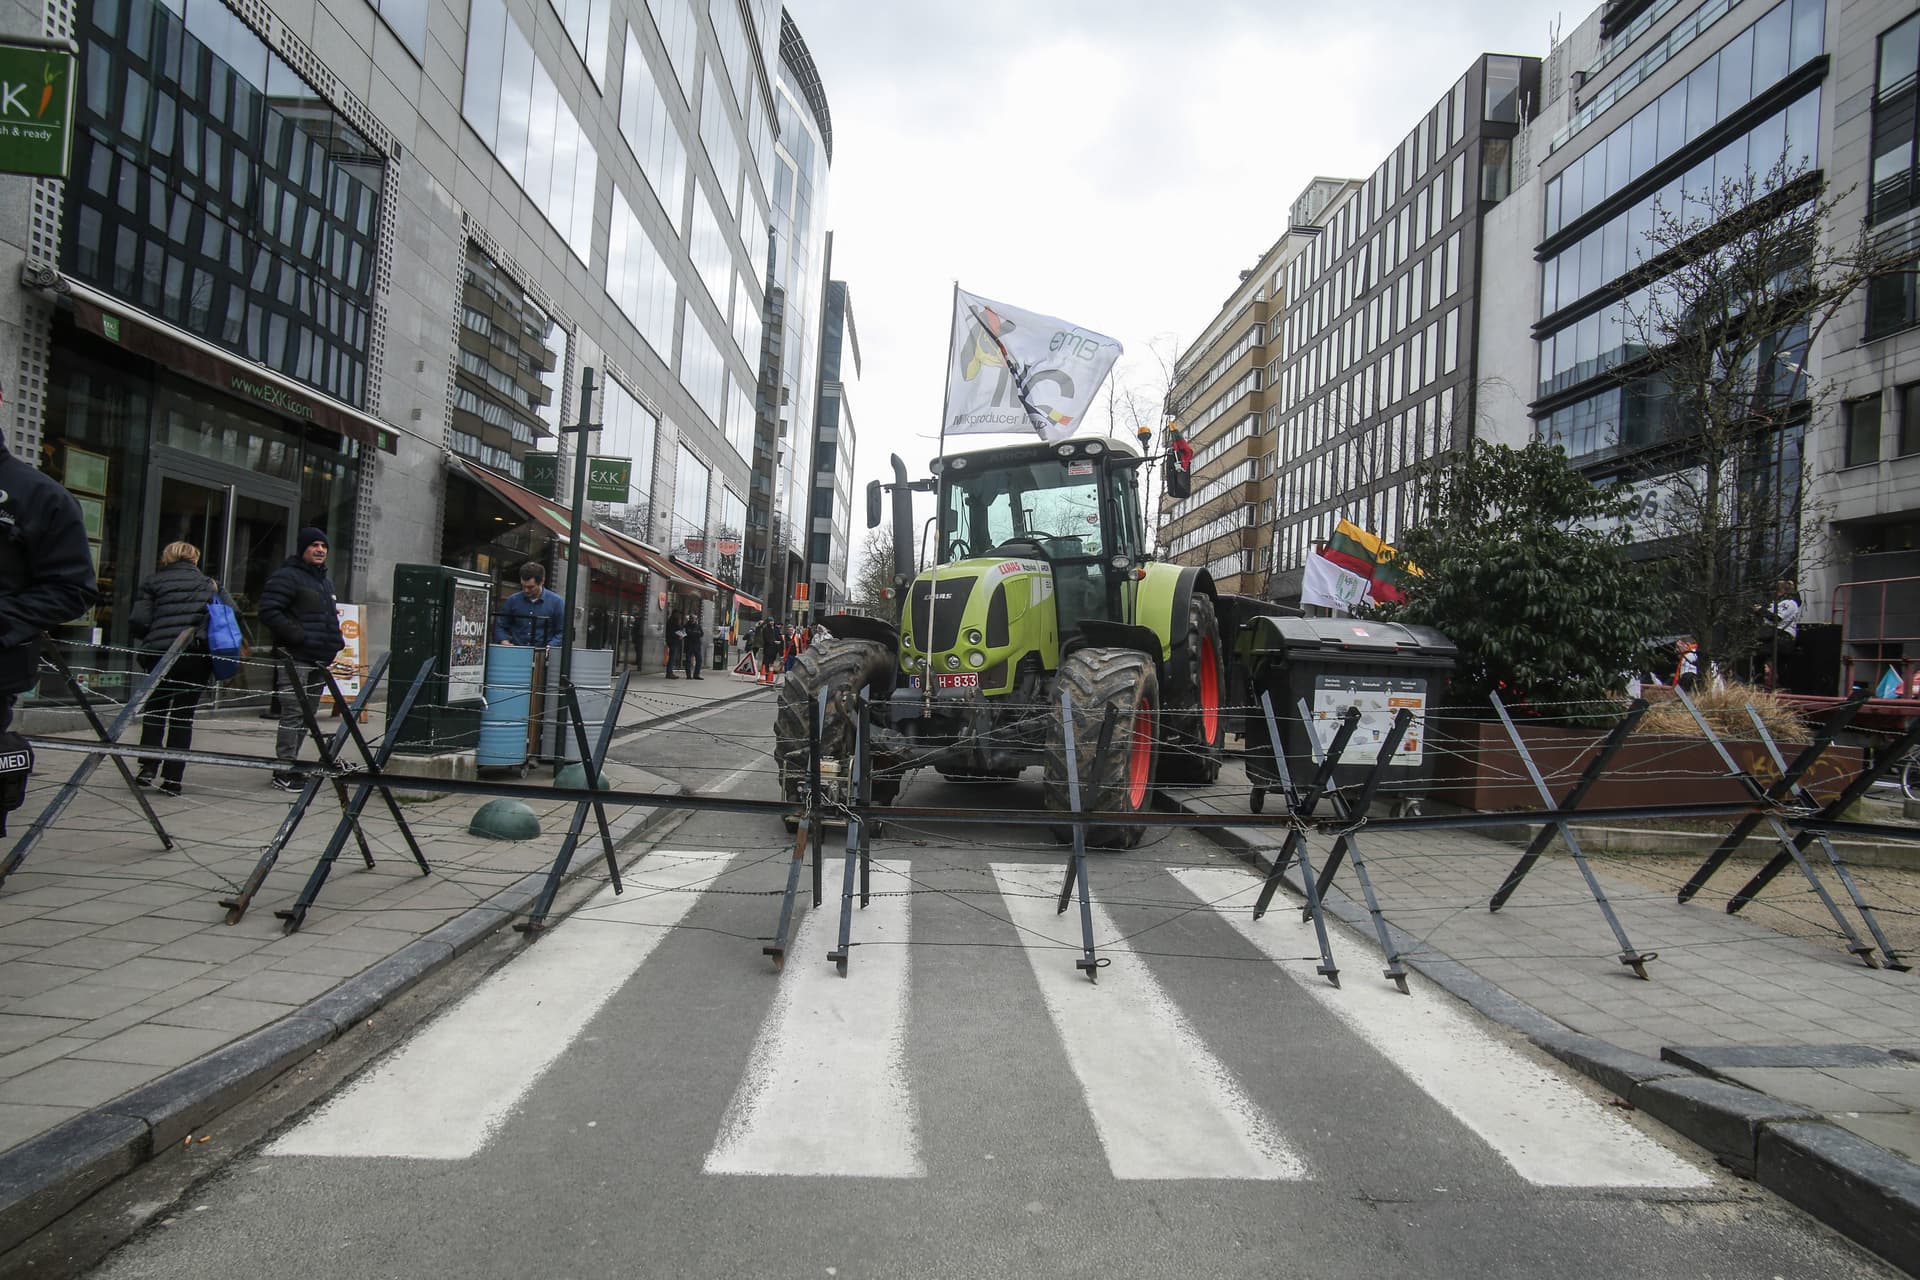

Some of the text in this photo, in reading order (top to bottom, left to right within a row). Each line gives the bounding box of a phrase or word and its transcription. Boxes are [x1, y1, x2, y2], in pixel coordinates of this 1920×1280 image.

[23, 129, 52, 142] ready
[998, 561, 1021, 575] CLAAS
[454, 615, 484, 636] elbow
[0, 754, 26, 769] MED
